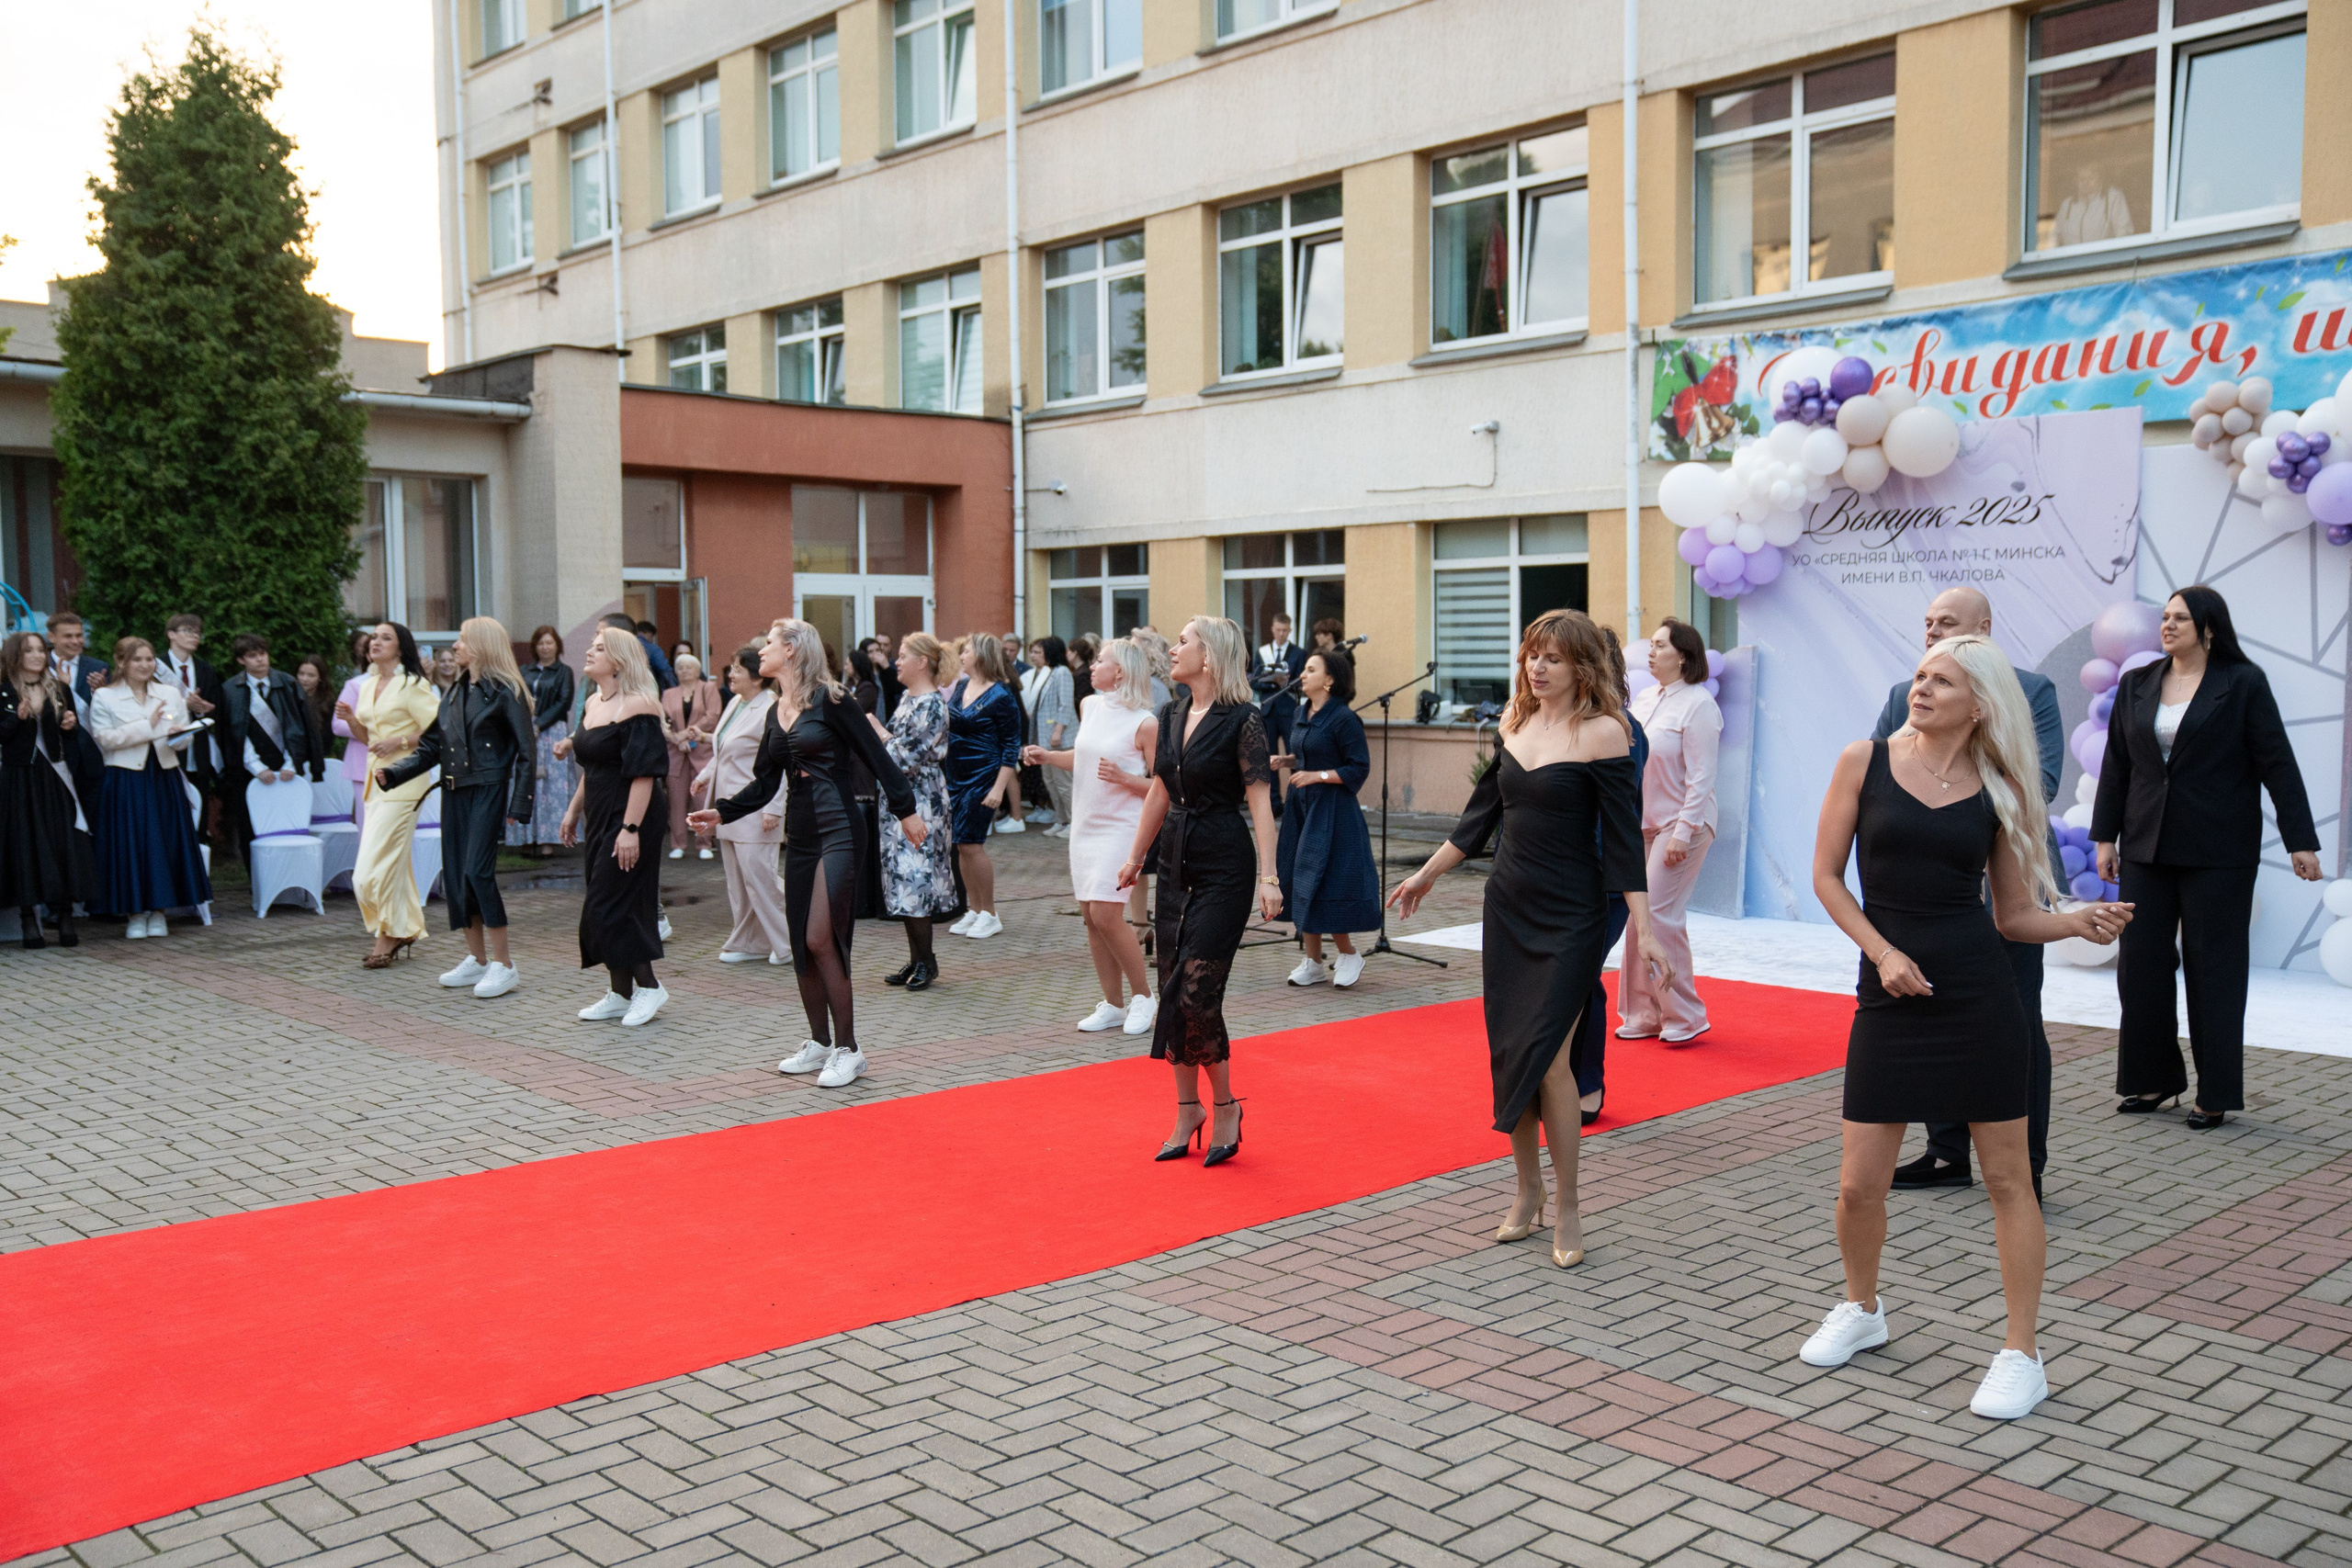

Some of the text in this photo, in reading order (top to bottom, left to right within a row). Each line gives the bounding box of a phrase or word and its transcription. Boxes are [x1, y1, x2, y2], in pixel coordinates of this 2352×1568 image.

[1803, 487, 2056, 549] Выпуск 2025
[1792, 553, 1812, 567] УО
[1814, 551, 1887, 566] «СРЕДНЯЯ
[1892, 548, 1948, 563] ШКОЛА
[1995, 545, 2066, 559] МИНСКА
[1841, 568, 2006, 584] ИМЕНИ В.П. ЧКАЛОВА
